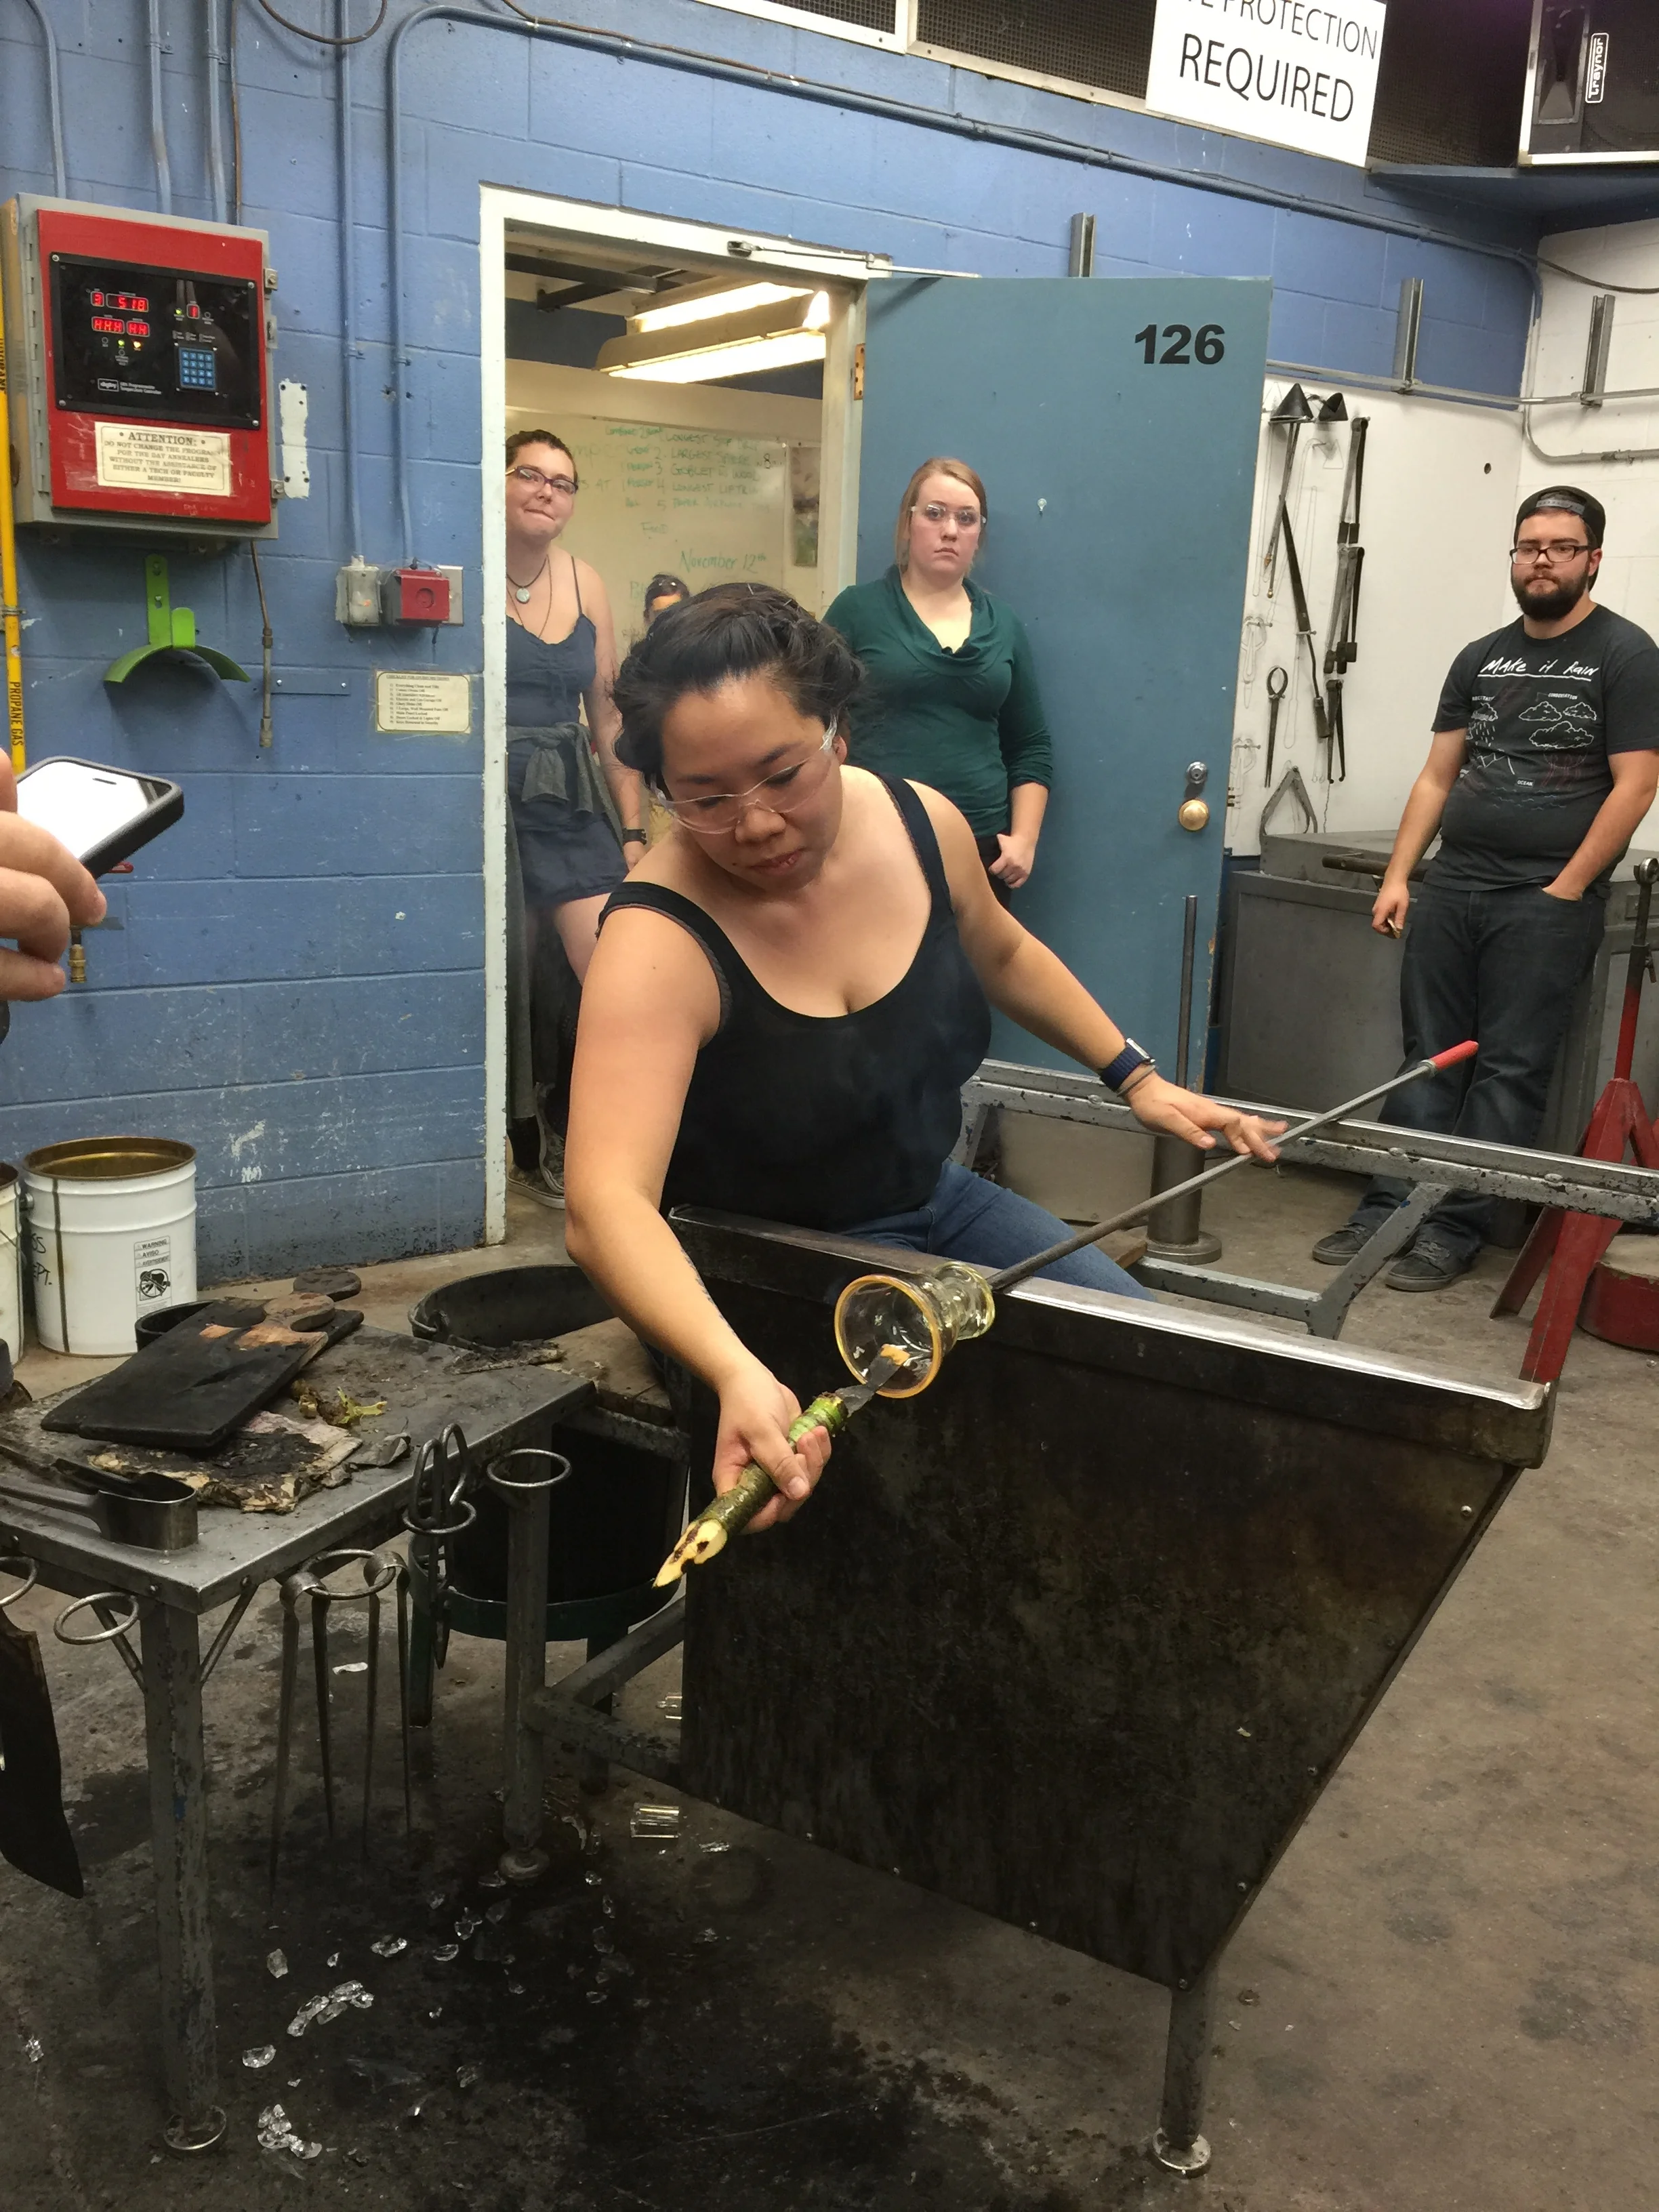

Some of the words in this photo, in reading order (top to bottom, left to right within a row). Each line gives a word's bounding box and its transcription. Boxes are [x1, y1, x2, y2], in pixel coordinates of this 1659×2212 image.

[1589, 38, 1603, 98] traynor
[1180, 33, 1353, 122] REQUIRED
[95, 294, 102, 306] 3
[118, 297, 146, 311] 518
[1134, 324, 1225, 365] 126
[128, 432, 197, 447] ATTENTION:
[134, 443, 163, 451] CHANGE
[109, 456, 143, 465] WITHOUT
[183, 470, 215, 478] FACULTY
[679, 548, 737, 573] November
[9, 681, 23, 725] PROPANE
[11, 728, 24, 746] GAS
[142, 1239, 167, 1249] WARNING
